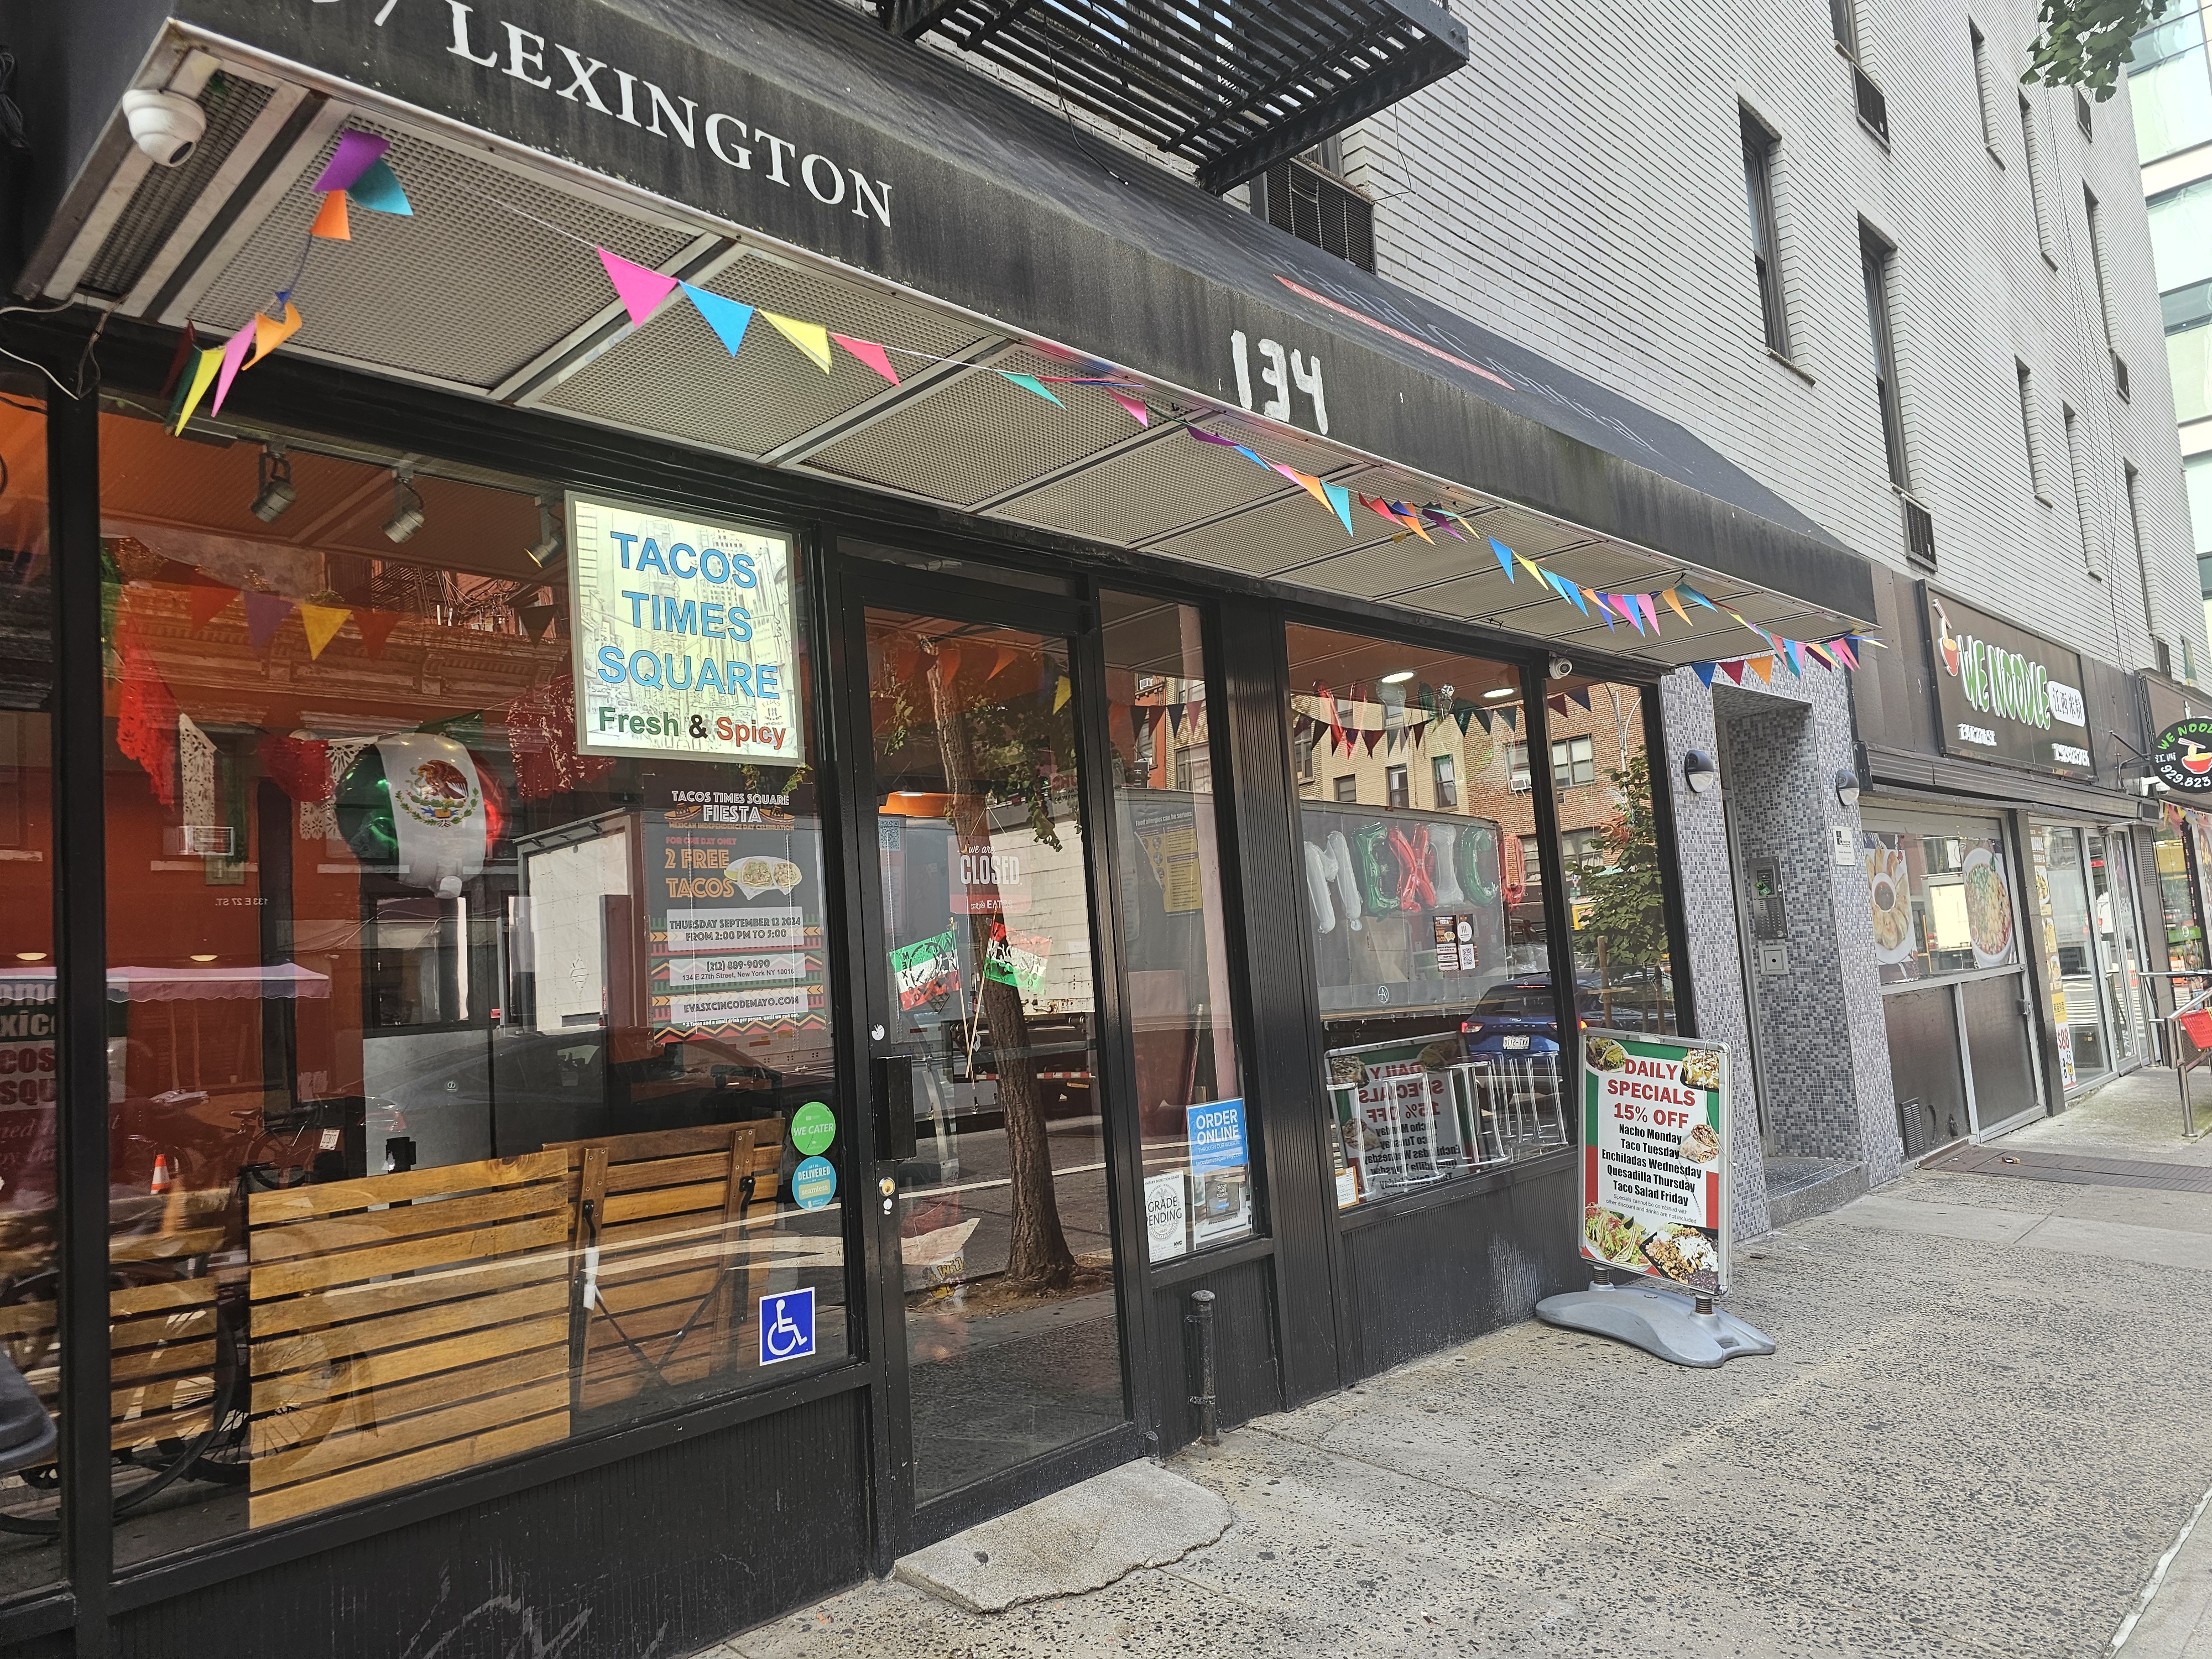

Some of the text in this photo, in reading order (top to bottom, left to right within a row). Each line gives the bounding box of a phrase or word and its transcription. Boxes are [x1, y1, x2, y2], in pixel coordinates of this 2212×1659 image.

[446, 0, 893, 228] LEXINGTON
[1194, 213, 1439, 343] Grand
[1427, 324, 1656, 452] Central
[1231, 330, 1328, 435] 134
[610, 531, 757, 589] TACOS
[622, 590, 753, 642] TIMES
[598, 646, 780, 699] SQUARE
[1957, 634, 2051, 730] WE NOODLE
[599, 706, 786, 749] Fresh & Spicy
[2157, 732, 2175, 750] WE
[672, 791, 790, 805] TACOS TIMES SQUARE
[703, 805, 762, 823] FIESTA
[666, 836, 682, 844] FOR
[968, 846, 980, 854] we
[665, 849, 729, 869] 2 FREE
[960, 855, 1019, 884] CLOSED
[666, 878, 734, 898] TACOS
[987, 900, 1012, 909] EAT24
[670, 920, 718, 930] THURSDAY
[719, 918, 770, 928] SEPTEMBER
[781, 917, 801, 926] 2024
[686, 928, 787, 941] FROM 2:00 PM TO 5:00
[707, 959, 770, 972] (212) 889-9090
[684, 997, 799, 1013] EVASXCINCODEMAYO.COM
[2058, 1028, 2069, 1050] $88
[1624, 1058, 1678, 1080] DAILY
[1608, 1079, 1695, 1107] SPECIALS
[1196, 1109, 1238, 1130] ORDER
[1614, 1103, 1689, 1129] 15% OFF
[794, 1123, 834, 1136] WE CATER
[1197, 1125, 1239, 1145] ONLINE
[1619, 1124, 1682, 1145] Nacho Monday
[1620, 1138, 1680, 1159] Taco Tuesday
[798, 1166, 830, 1181] DELIVERED
[1601, 1149, 1702, 1179] Enchiladas Wednesday
[1607, 1165, 1695, 1193] Quesadilla Thursday
[801, 1185, 828, 1195] seamless
[1613, 1180, 1689, 1207] Taco Salad Friday
[1148, 1196, 1177, 1212] GRADE
[1614, 1193, 1631, 1202] Specials
[1655, 1204, 1677, 1212] combined
[1677, 1215, 1697, 1224] included
